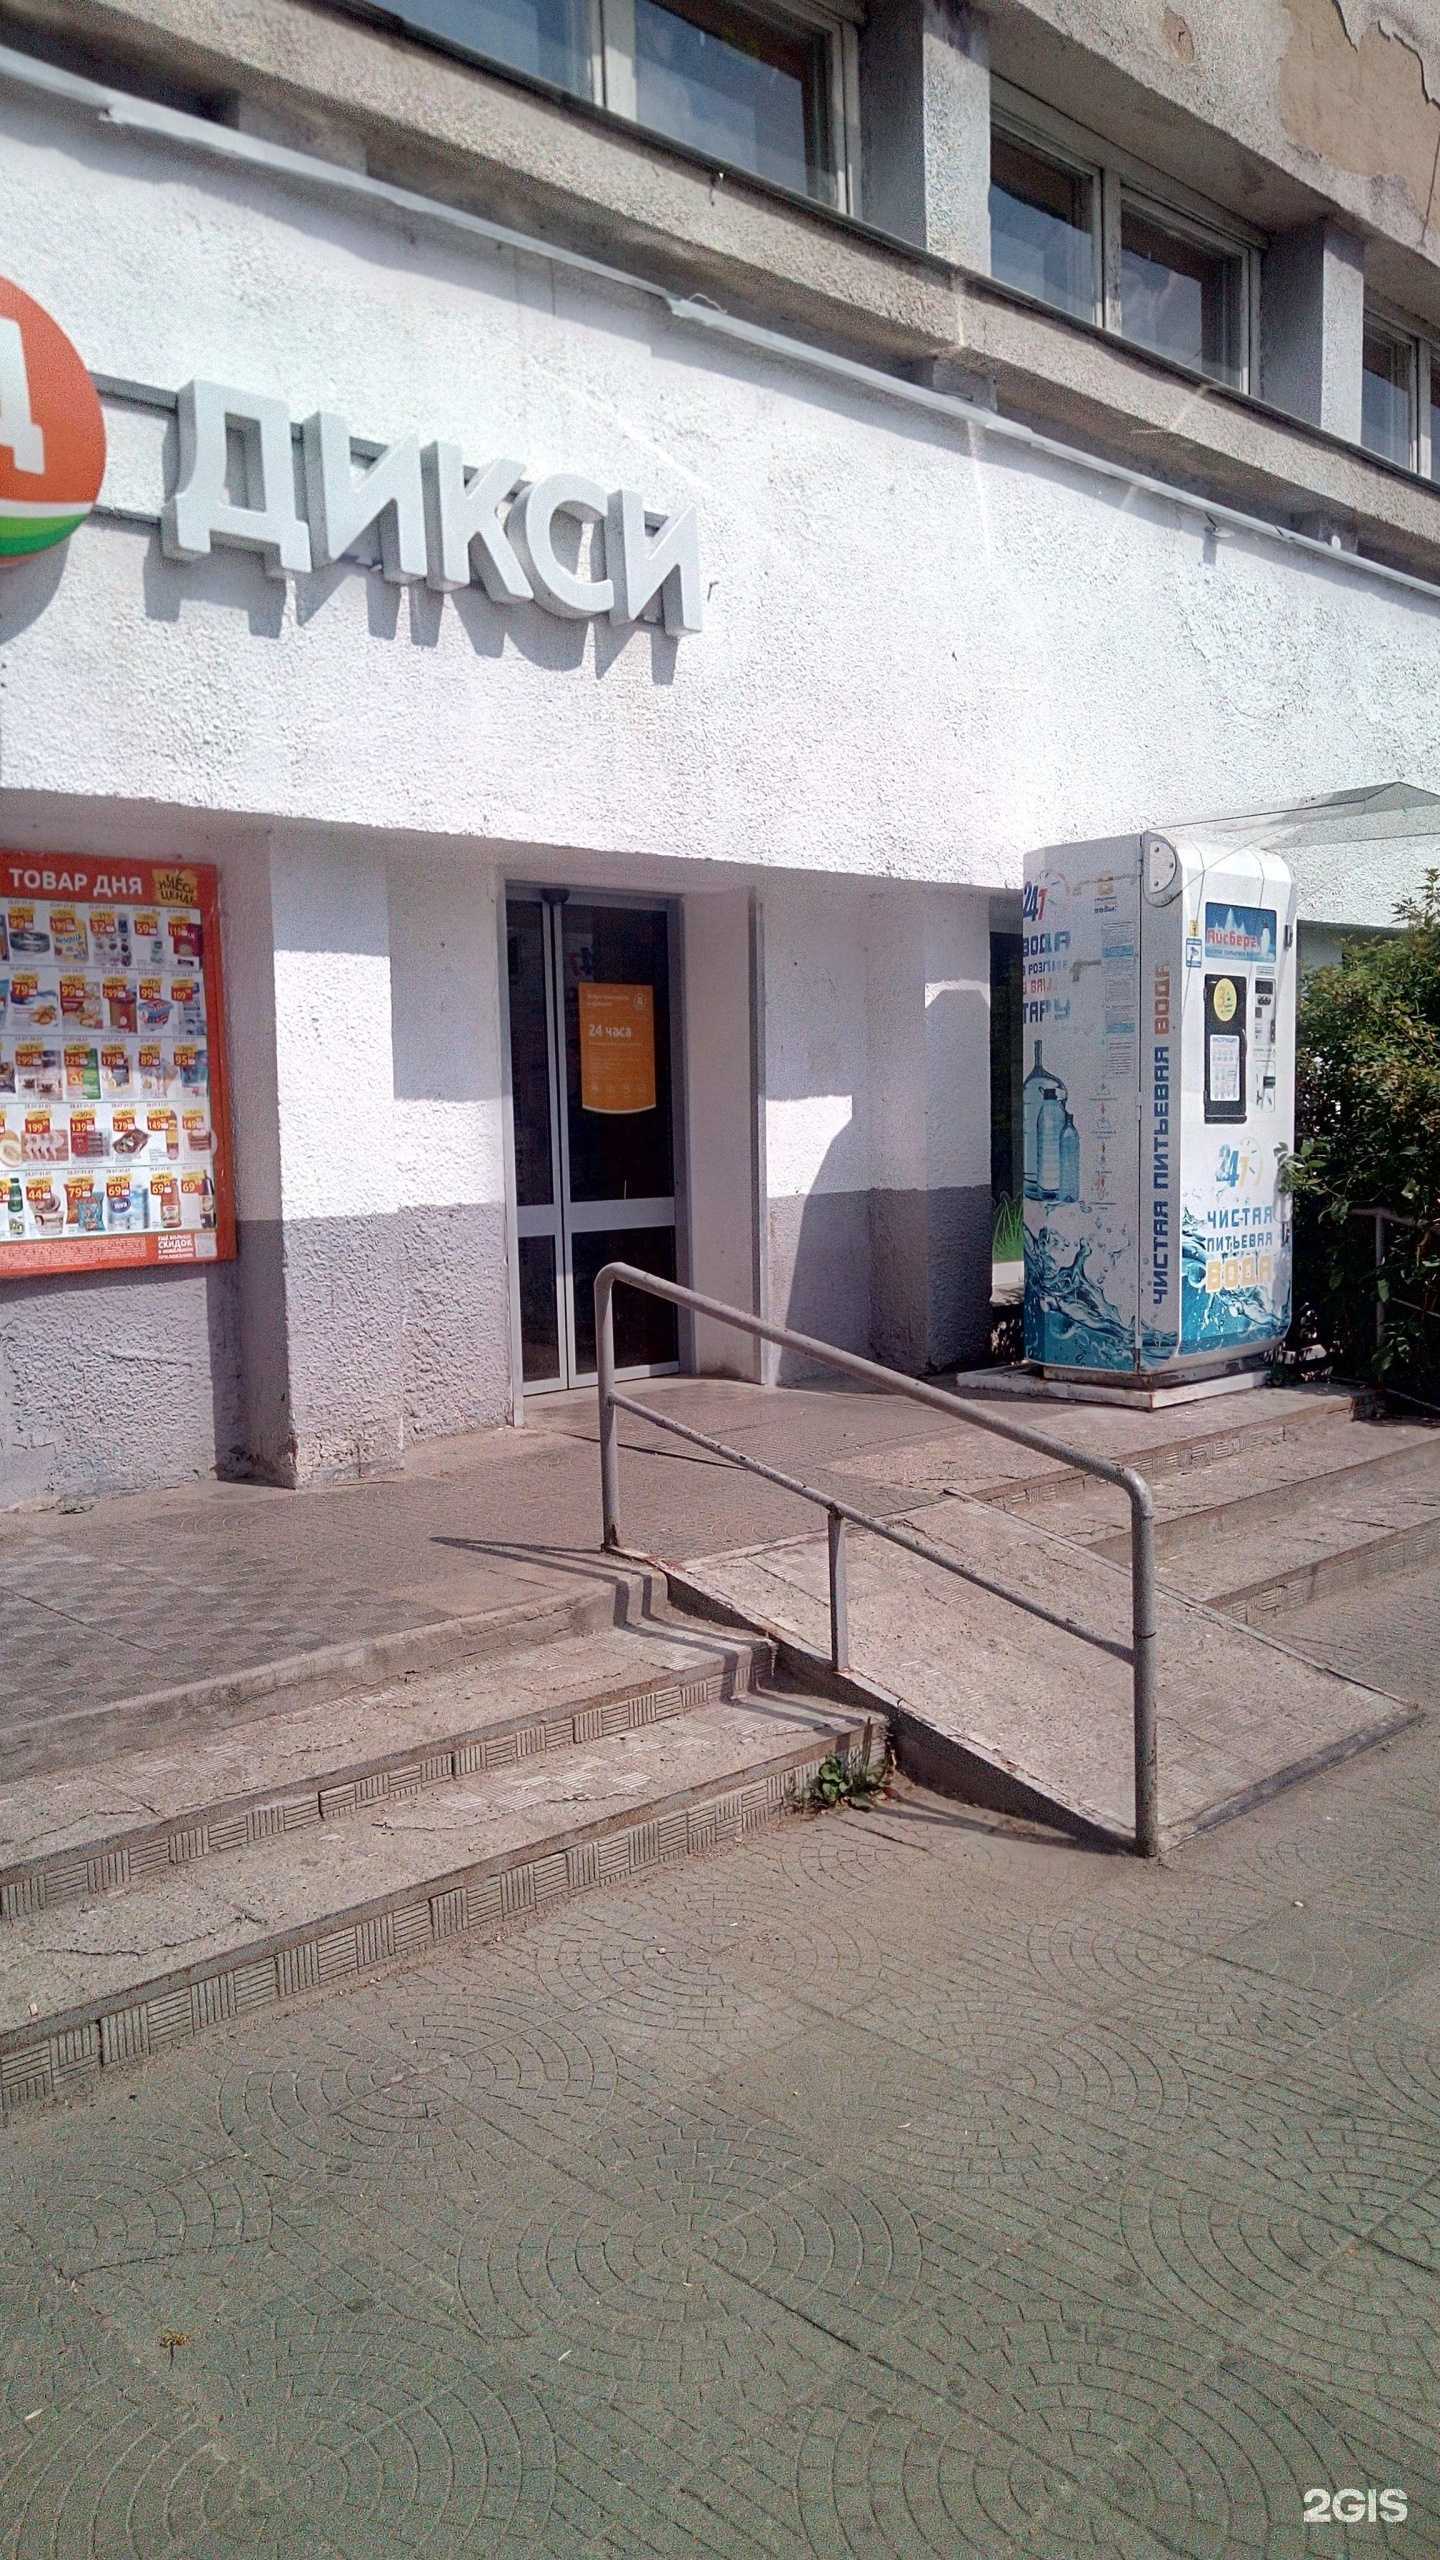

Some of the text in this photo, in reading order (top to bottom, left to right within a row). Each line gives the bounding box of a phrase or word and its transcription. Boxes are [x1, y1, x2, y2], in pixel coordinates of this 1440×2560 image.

[168, 380, 702, 637] ДИКСИ
[9, 868, 88, 892] ТОВАР
[93, 875, 143, 897] ДНЯ
[588, 1024, 632, 1039] 24 часа
[1154, 1046, 1170, 1190] ПИТЬЕВАЯ
[28, 1189, 42, 1200] 44
[68, 1187, 82, 1198] 79
[108, 1186, 121, 1196] 69
[152, 1183, 164, 1194] 69
[182, 1182, 195, 1193] 69
[1207, 1206, 1273, 1229] ЧИСТАЯ
[158, 1240, 193, 1249] СКИДОК
[1206, 1232, 1273, 1252] ПИТЬЕВАЯ
[1153, 1201, 1169, 1305] ЧИСТАЯ
[1206, 1254, 1272, 1291] ВОДА
